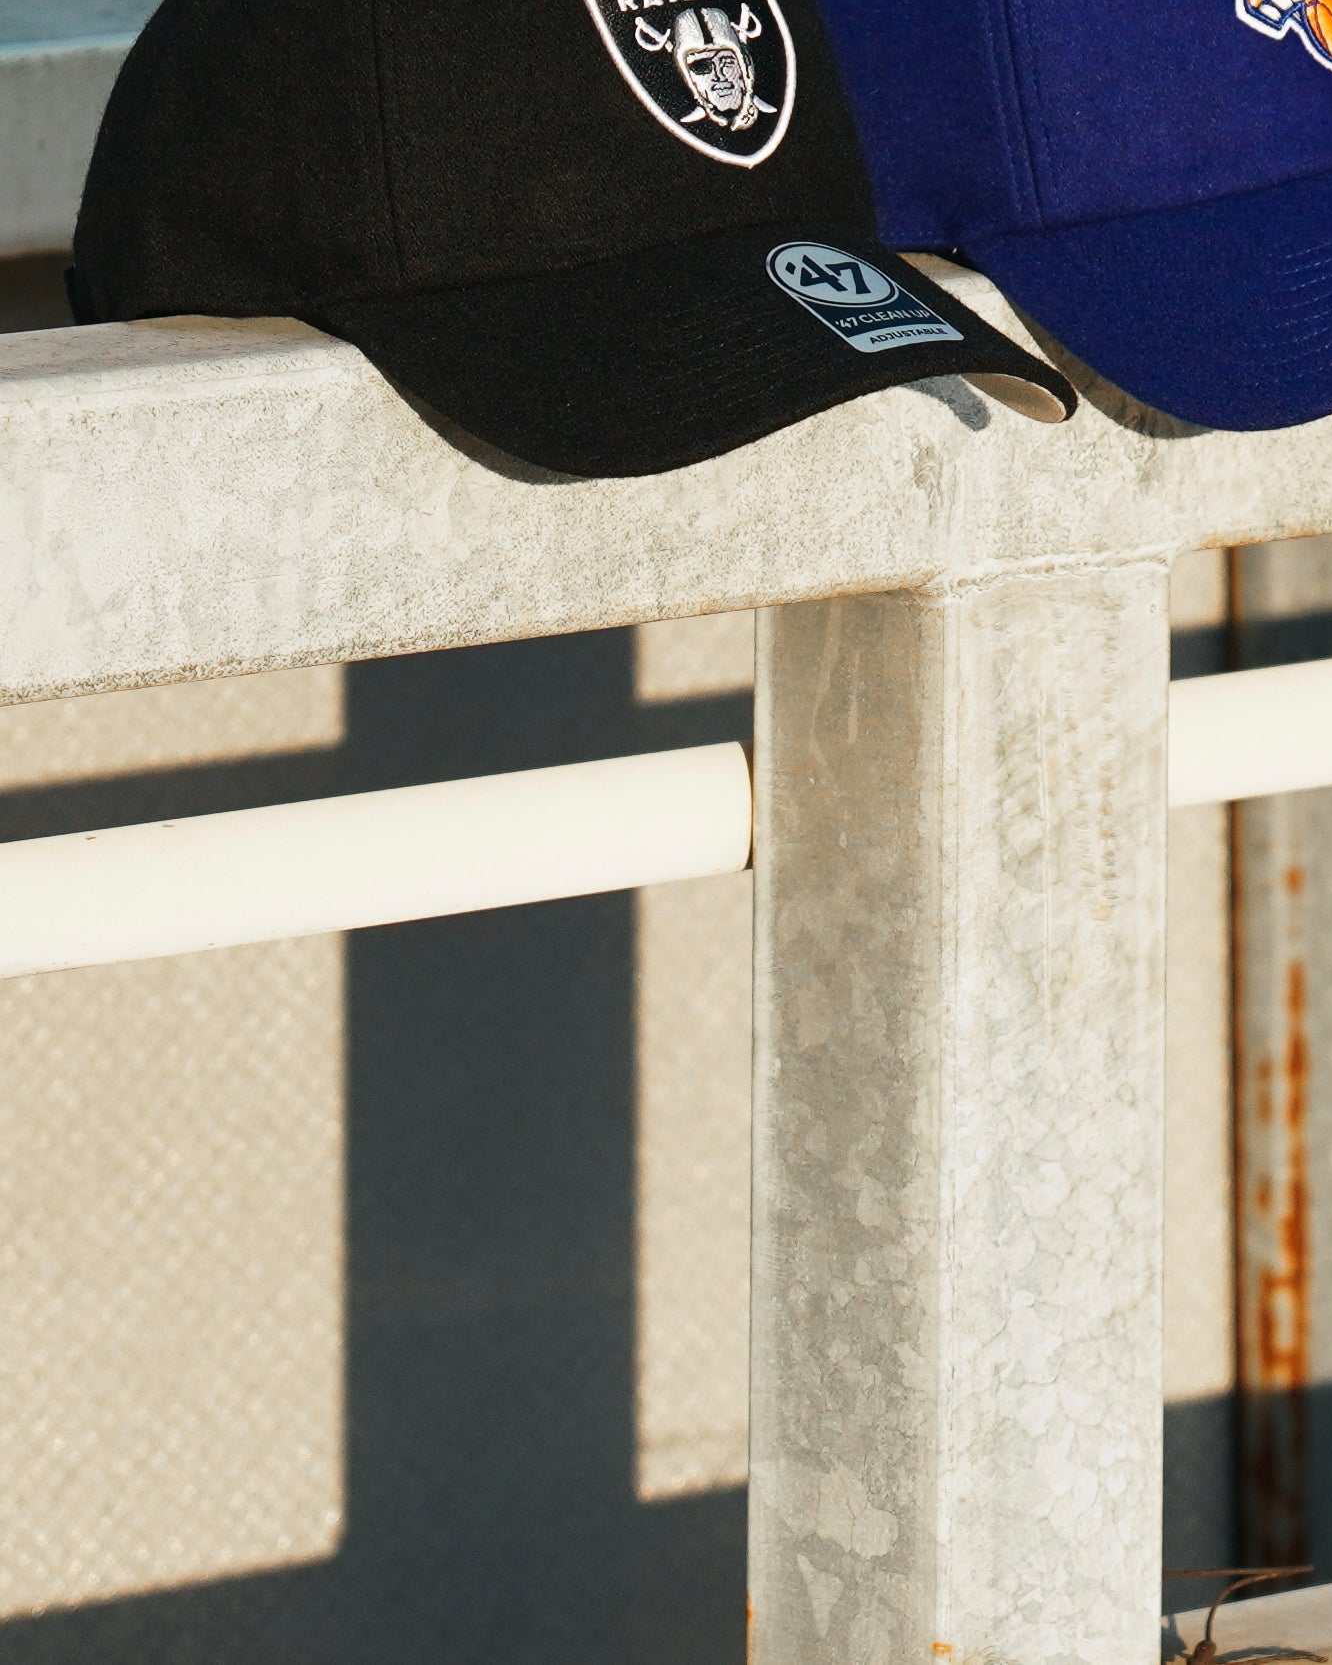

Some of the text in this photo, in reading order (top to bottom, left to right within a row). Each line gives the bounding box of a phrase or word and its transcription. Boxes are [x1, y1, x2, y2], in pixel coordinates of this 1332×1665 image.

[858, 309, 912, 323] CLEAN
[909, 308, 931, 319] UP
[869, 326, 950, 344] ADJUSTABLE
